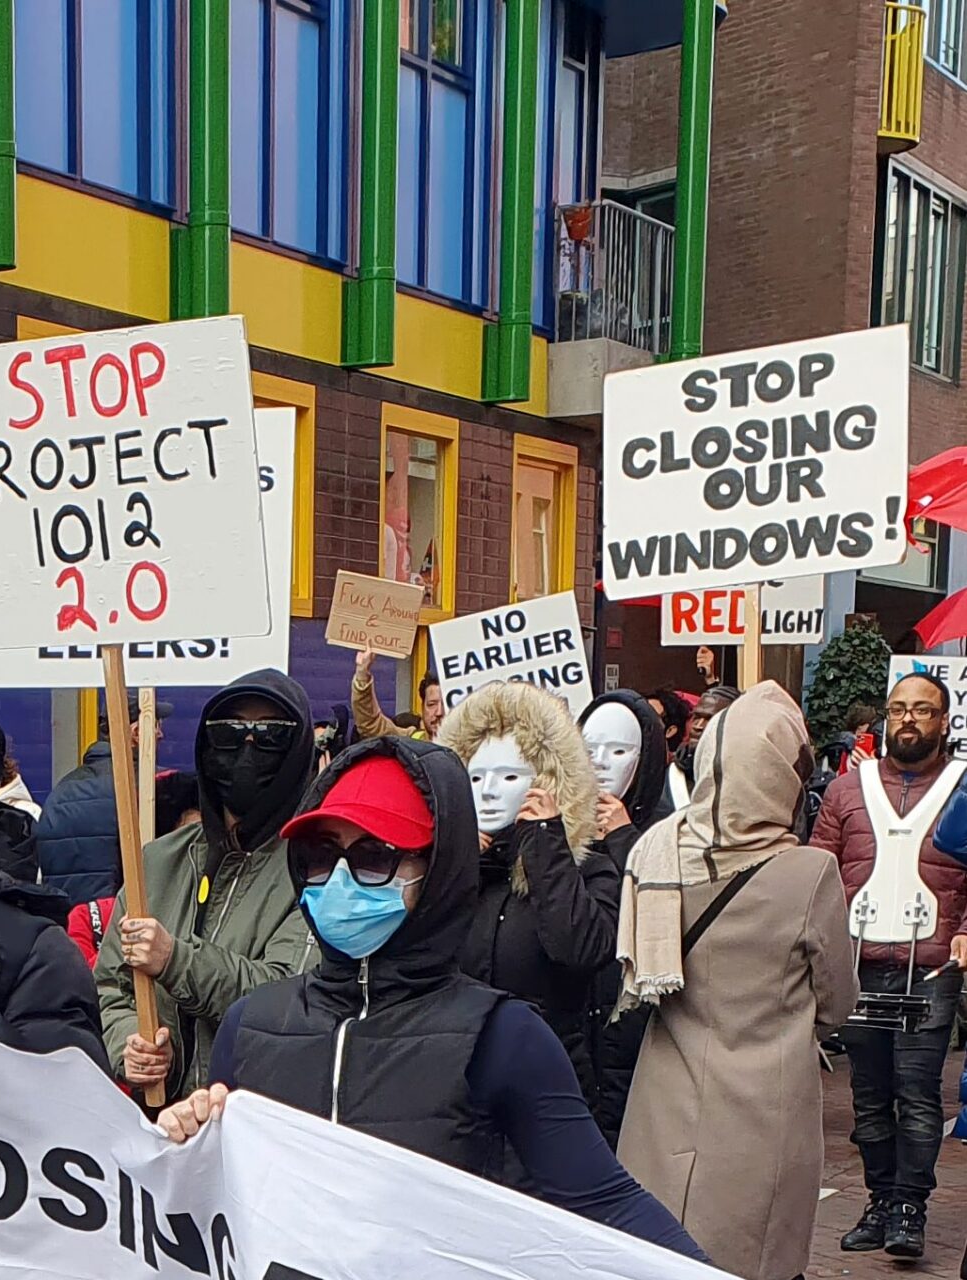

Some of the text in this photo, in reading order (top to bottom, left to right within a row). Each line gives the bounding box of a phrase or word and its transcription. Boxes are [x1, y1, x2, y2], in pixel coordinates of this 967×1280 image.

[9, 343, 164, 429] STOP
[681, 353, 834, 412] STOP
[623, 405, 876, 479] CLOSING
[703, 458, 825, 510] OUR
[33, 491, 161, 567] 1012
[56, 561, 168, 632] 2.0
[481, 610, 526, 640] NO
[762, 608, 824, 634] LIGHT
[442, 629, 575, 680] EARLIER
